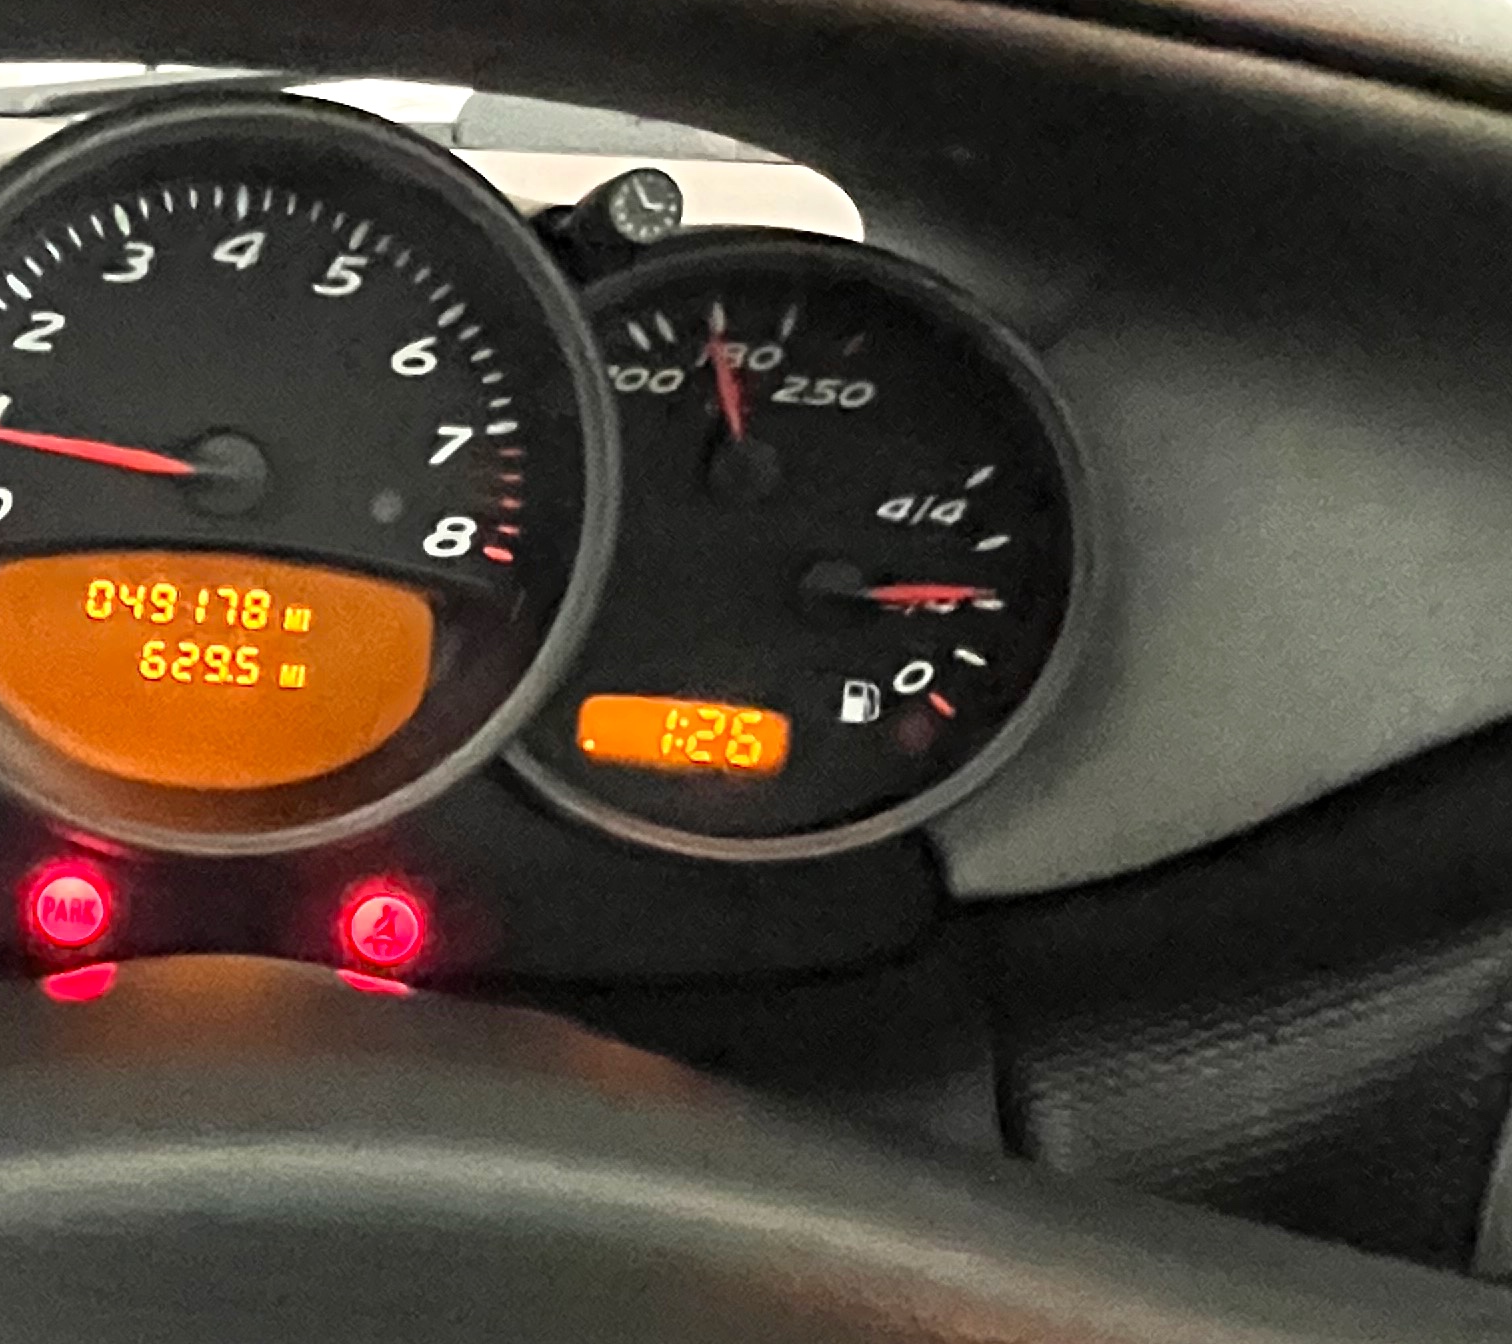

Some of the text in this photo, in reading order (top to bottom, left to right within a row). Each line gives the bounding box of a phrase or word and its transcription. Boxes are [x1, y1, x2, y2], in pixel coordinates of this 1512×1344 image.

[102, 240, 155, 283] 3
[212, 231, 266, 270] 4
[312, 255, 369, 297] 5
[12, 310, 66, 352] 2
[391, 336, 438, 376] 6
[607, 364, 685, 394] 00
[770, 374, 876, 408] 250
[428, 426, 474, 465] 7
[876, 495, 968, 526] 4/4
[423, 516, 478, 557] 8
[86, 579, 272, 630] 049178
[139, 640, 260, 686] 629.5
[892, 660, 935, 695] 0
[661, 708, 763, 766] 1:26
[42, 895, 97, 926] PARK
